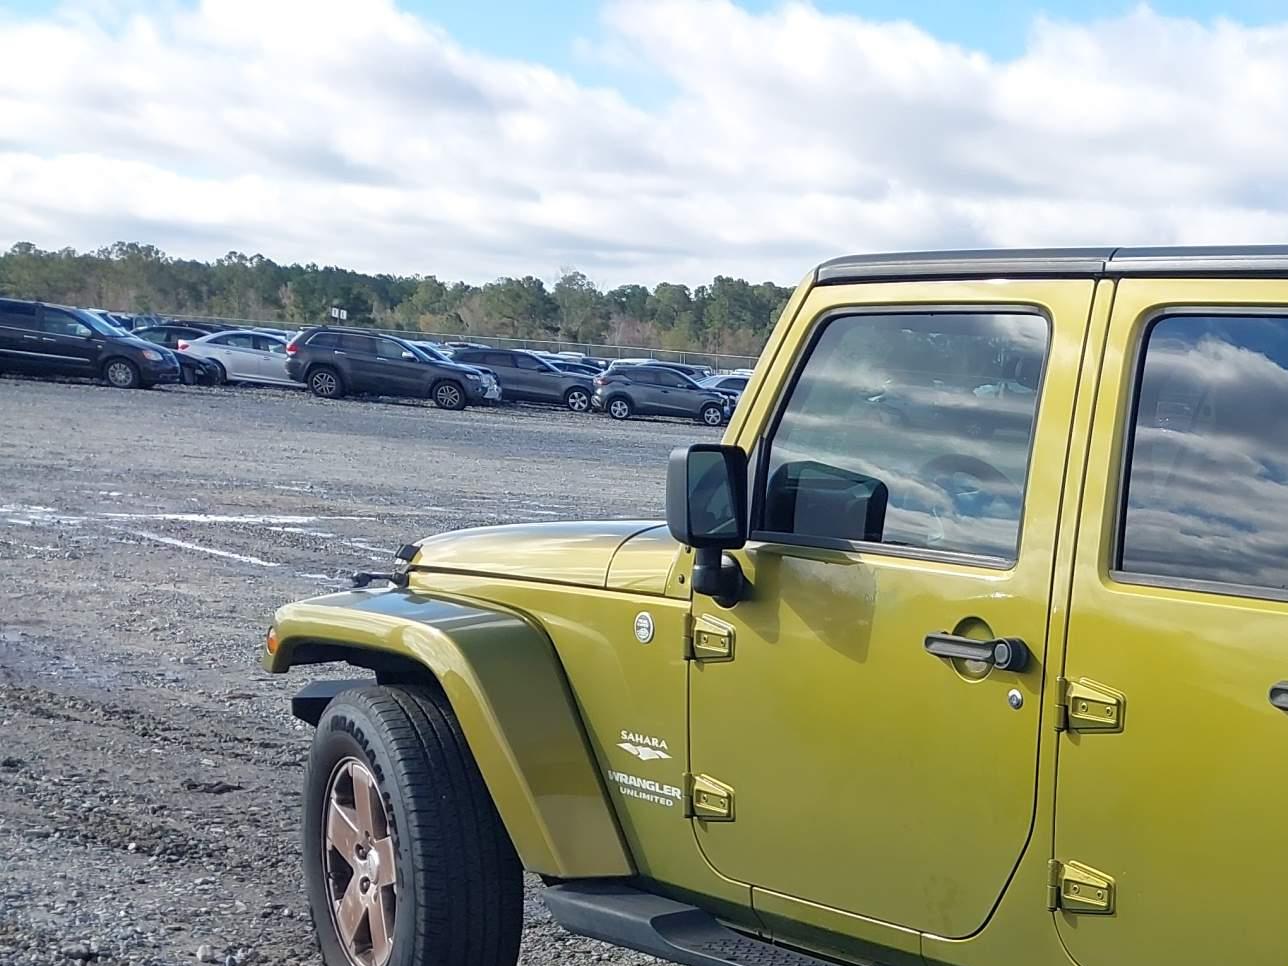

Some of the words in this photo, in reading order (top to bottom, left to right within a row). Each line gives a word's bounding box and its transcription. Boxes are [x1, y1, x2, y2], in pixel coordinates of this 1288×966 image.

[620, 729, 669, 750] SAHARA
[607, 769, 682, 800] WRANGLER
[619, 786, 674, 807] UNLIMITED
